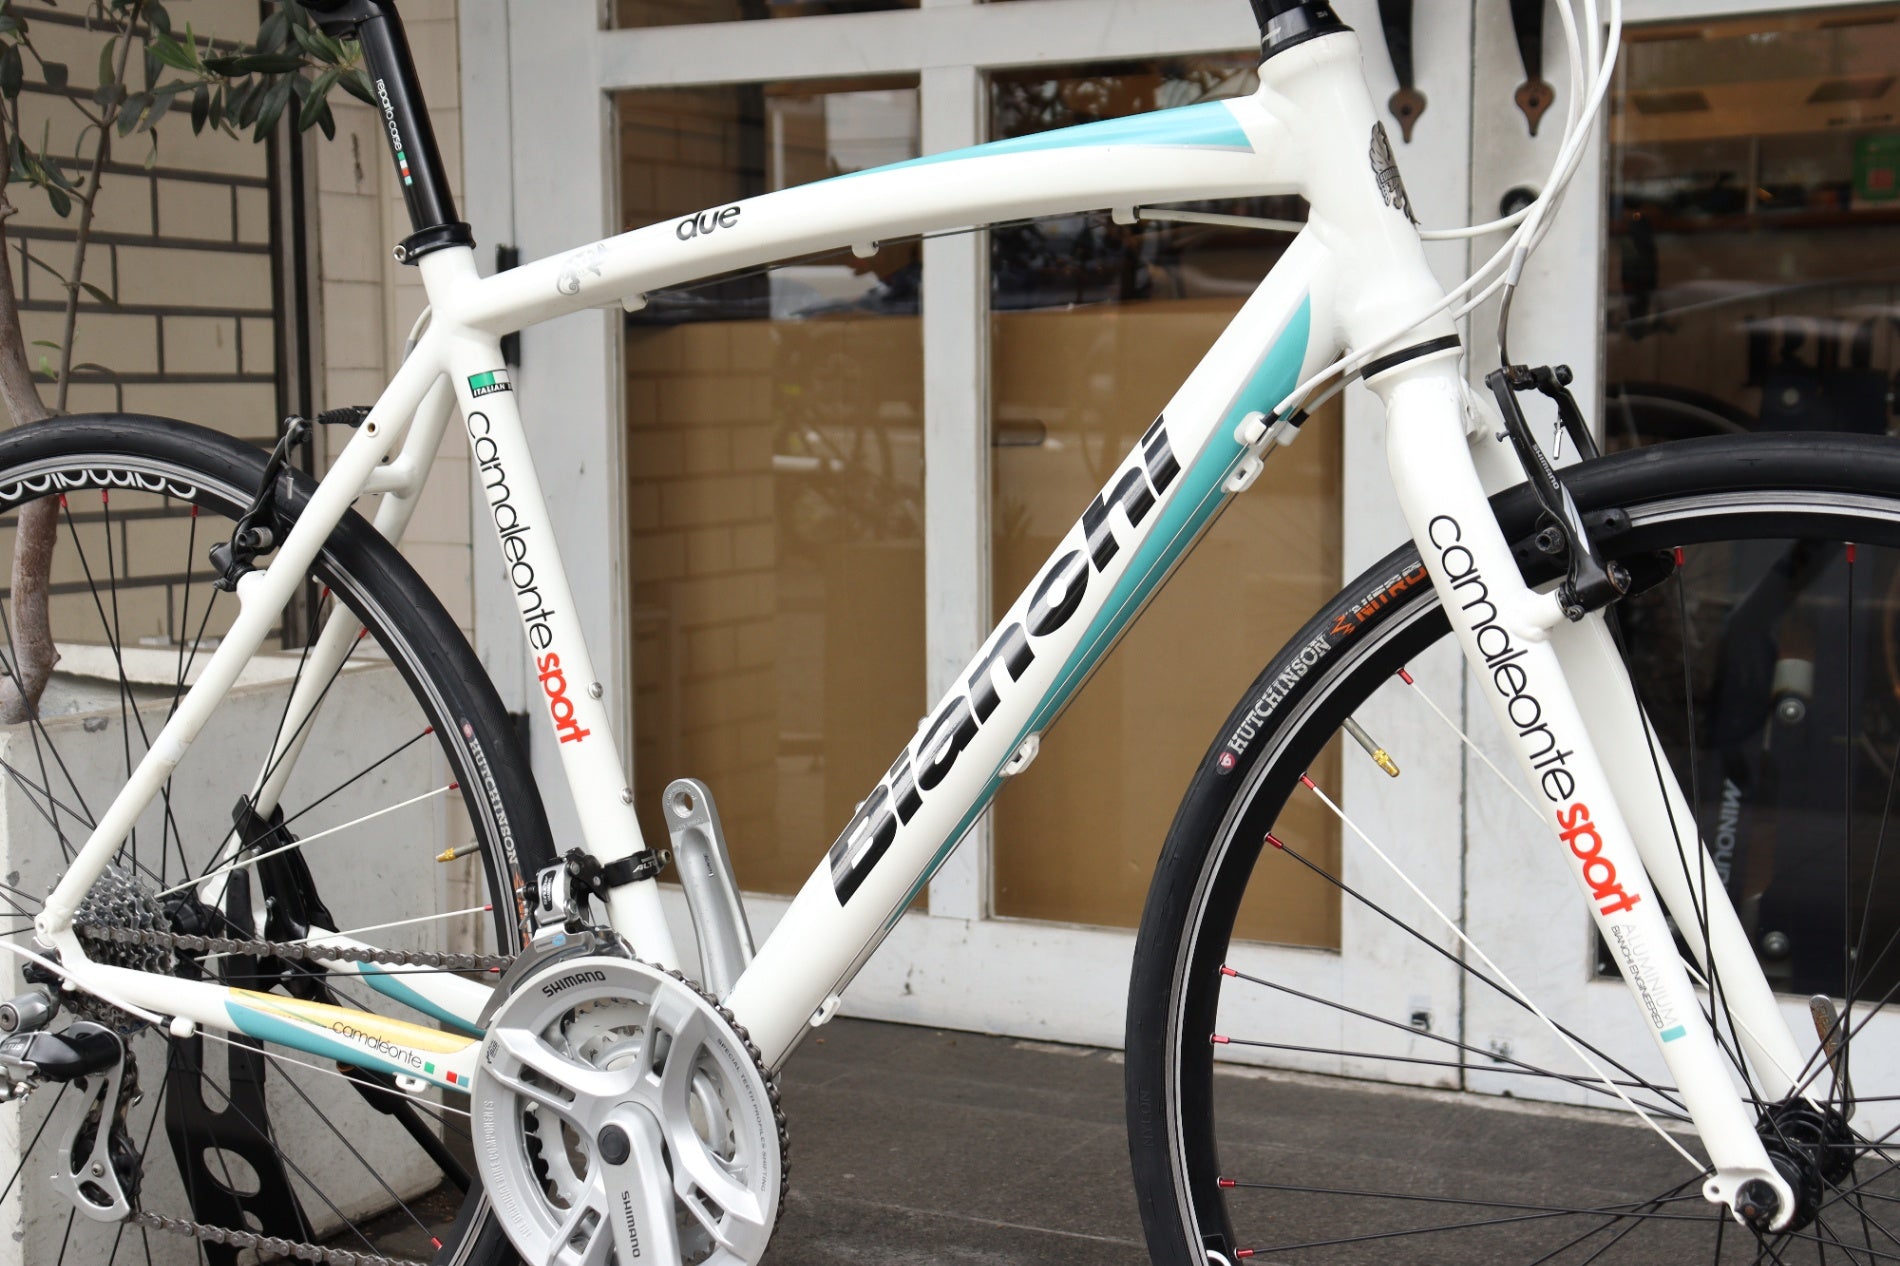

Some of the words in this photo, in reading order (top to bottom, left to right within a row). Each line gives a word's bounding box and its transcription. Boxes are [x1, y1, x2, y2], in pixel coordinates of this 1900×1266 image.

[376, 79, 395, 120] reparto
[388, 120, 403, 152] corse
[675, 205, 741, 241] due
[473, 383, 506, 397] ITALIAN
[1532, 443, 1560, 490] SHIMANO
[1226, 631, 1332, 755] HUTCHINSON
[468, 737, 519, 865] HUTCHINSON
[1713, 778, 1742, 890] MINOUR
[541, 970, 607, 998] SHIMANO
[1611, 924, 1634, 965] BIANCHI
[1629, 964, 1664, 1029] ENGINEERED
[1621, 924, 1678, 1027] ALUMINIUM
[332, 1021, 422, 1069] camaleonte
[621, 1190, 641, 1258] SHIMANO
